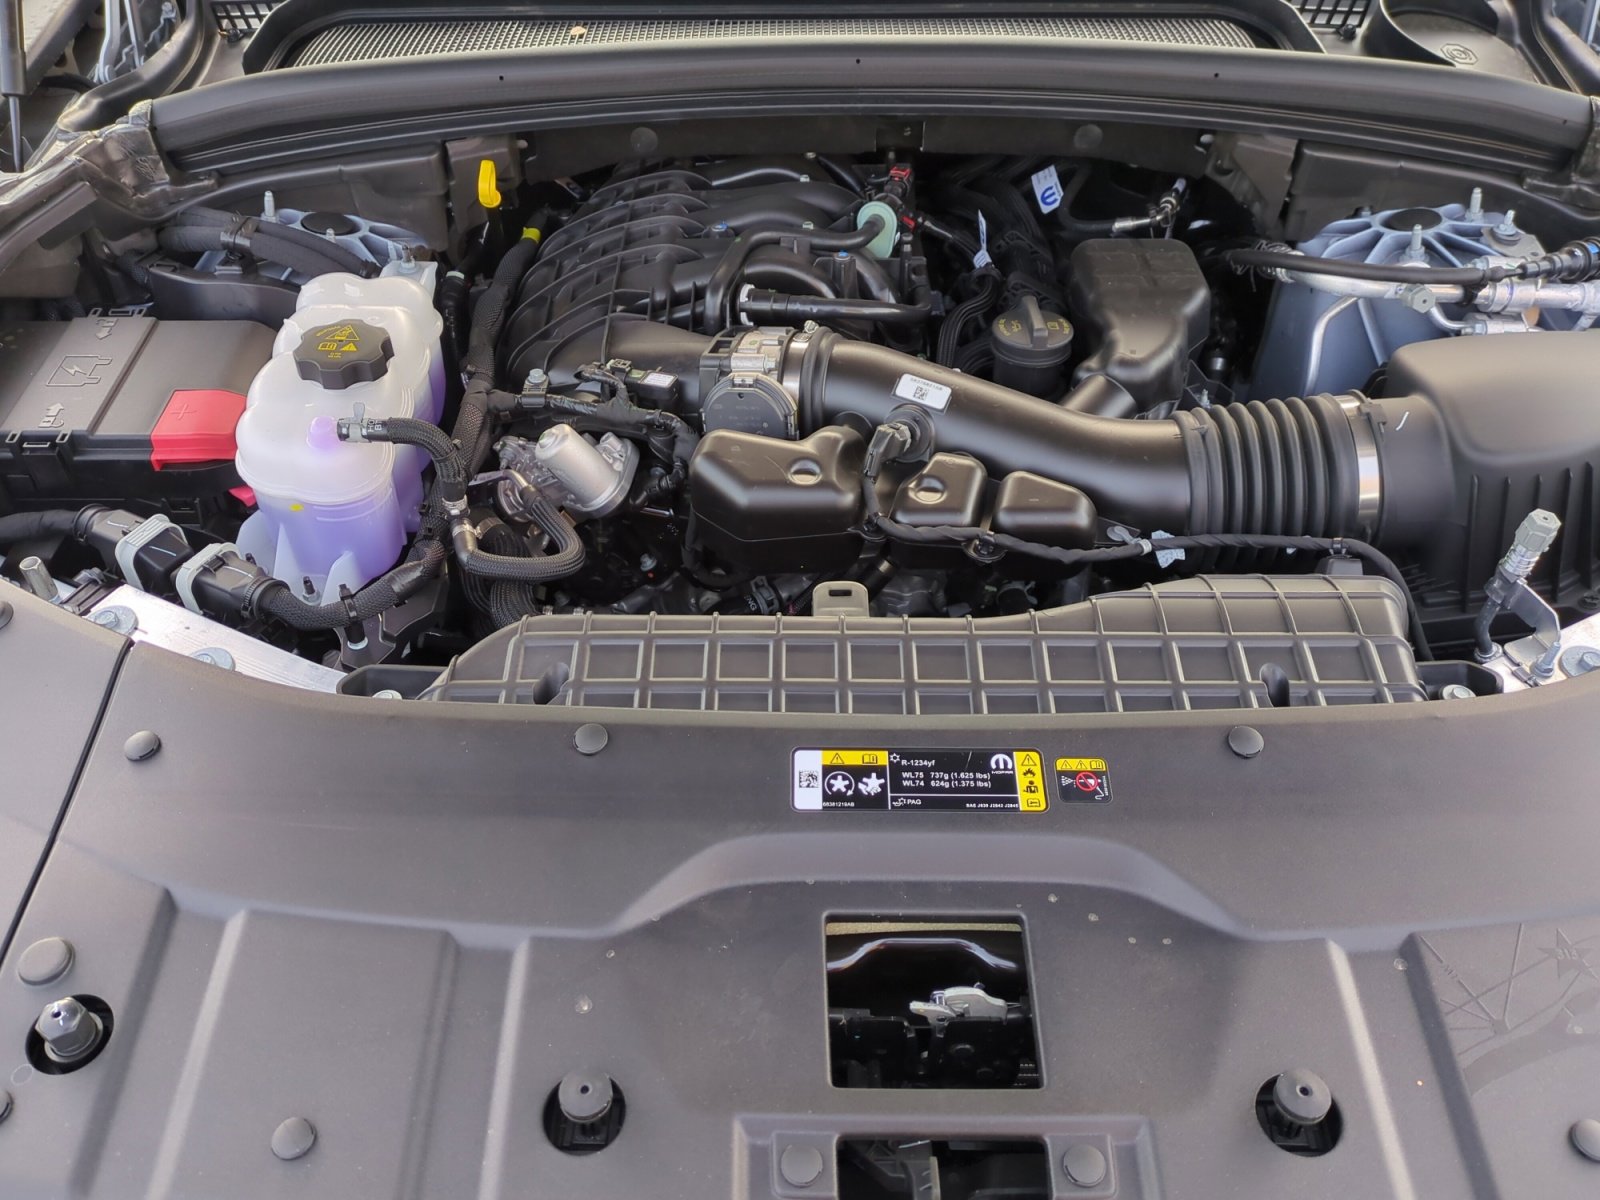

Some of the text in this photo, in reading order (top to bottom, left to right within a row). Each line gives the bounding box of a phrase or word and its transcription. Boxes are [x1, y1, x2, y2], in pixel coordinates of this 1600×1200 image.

[930, 772, 949, 780] 737g
[951, 772, 974, 780] (1.625
[976, 772, 990, 780] lbs)
[977, 780, 991, 788] lbs)
